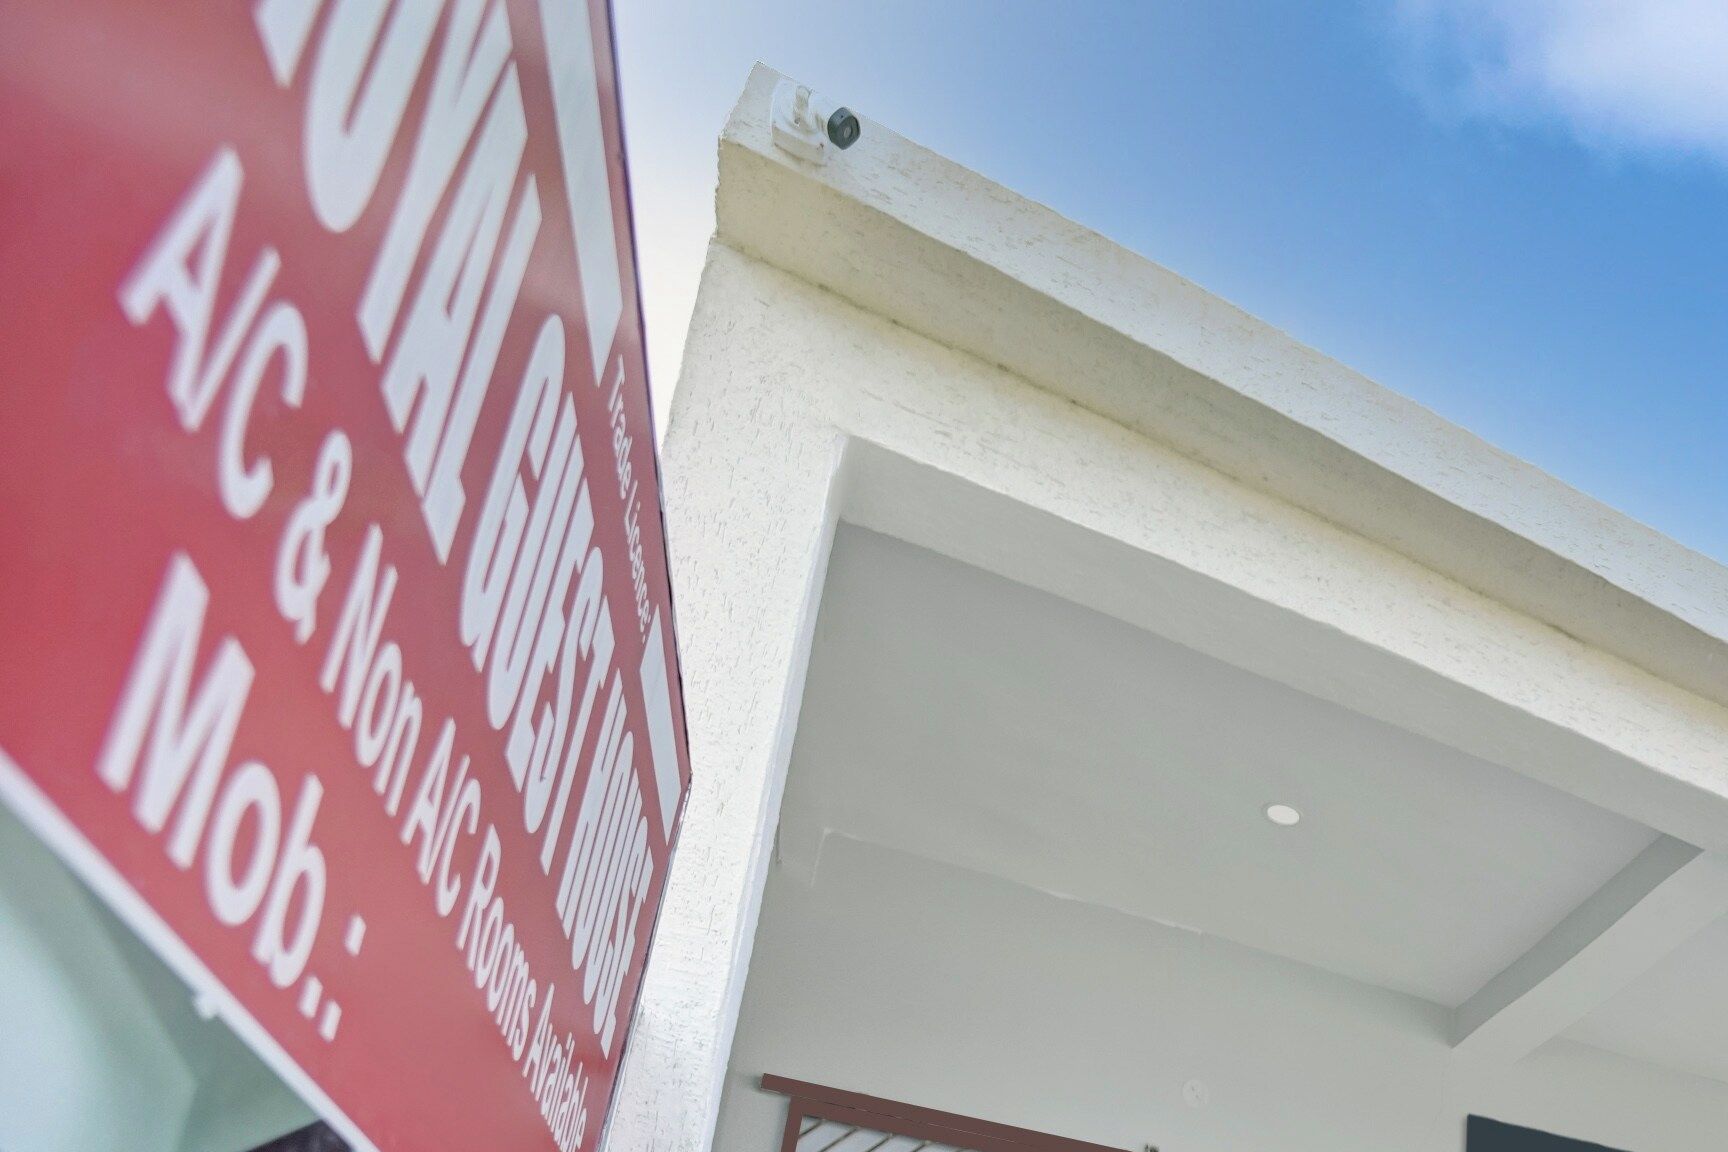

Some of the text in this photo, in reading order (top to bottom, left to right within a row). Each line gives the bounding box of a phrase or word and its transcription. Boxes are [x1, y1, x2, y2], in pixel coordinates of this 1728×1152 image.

[116, 145, 309, 520] A/C
[273, 430, 352, 646] &
[319, 522, 422, 816] Non
[402, 717, 482, 918] A/C
[456, 823, 538, 1062] Rooms
[254, 0, 654, 1060] OYAL GUEST HOUSE
[608, 353, 633, 500] Trade
